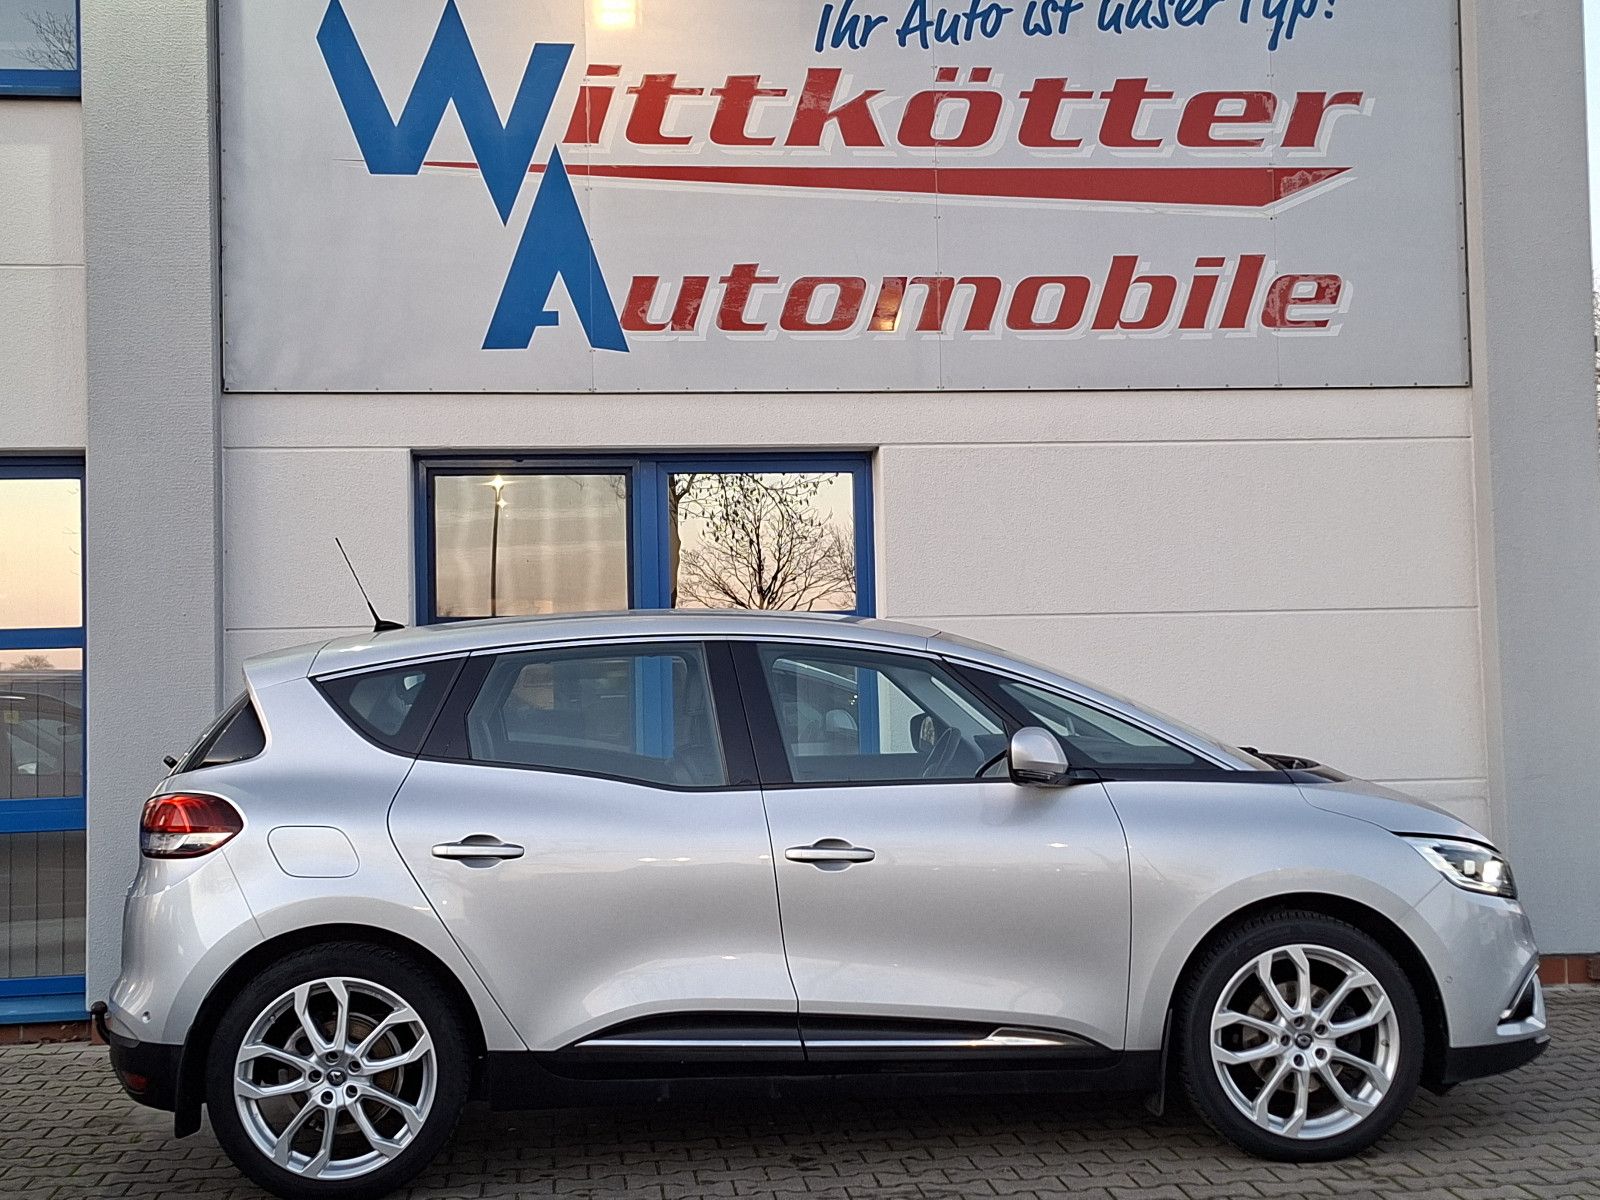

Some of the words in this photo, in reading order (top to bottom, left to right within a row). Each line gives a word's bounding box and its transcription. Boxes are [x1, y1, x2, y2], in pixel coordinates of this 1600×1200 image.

[316, 0, 1366, 228] Wittkötter
[816, 0, 889, 53] Ihr
[896, 0, 1014, 50] Auto
[1023, 0, 1085, 37] ist
[1097, 0, 1226, 35] unser
[481, 143, 1345, 354] Automobile
